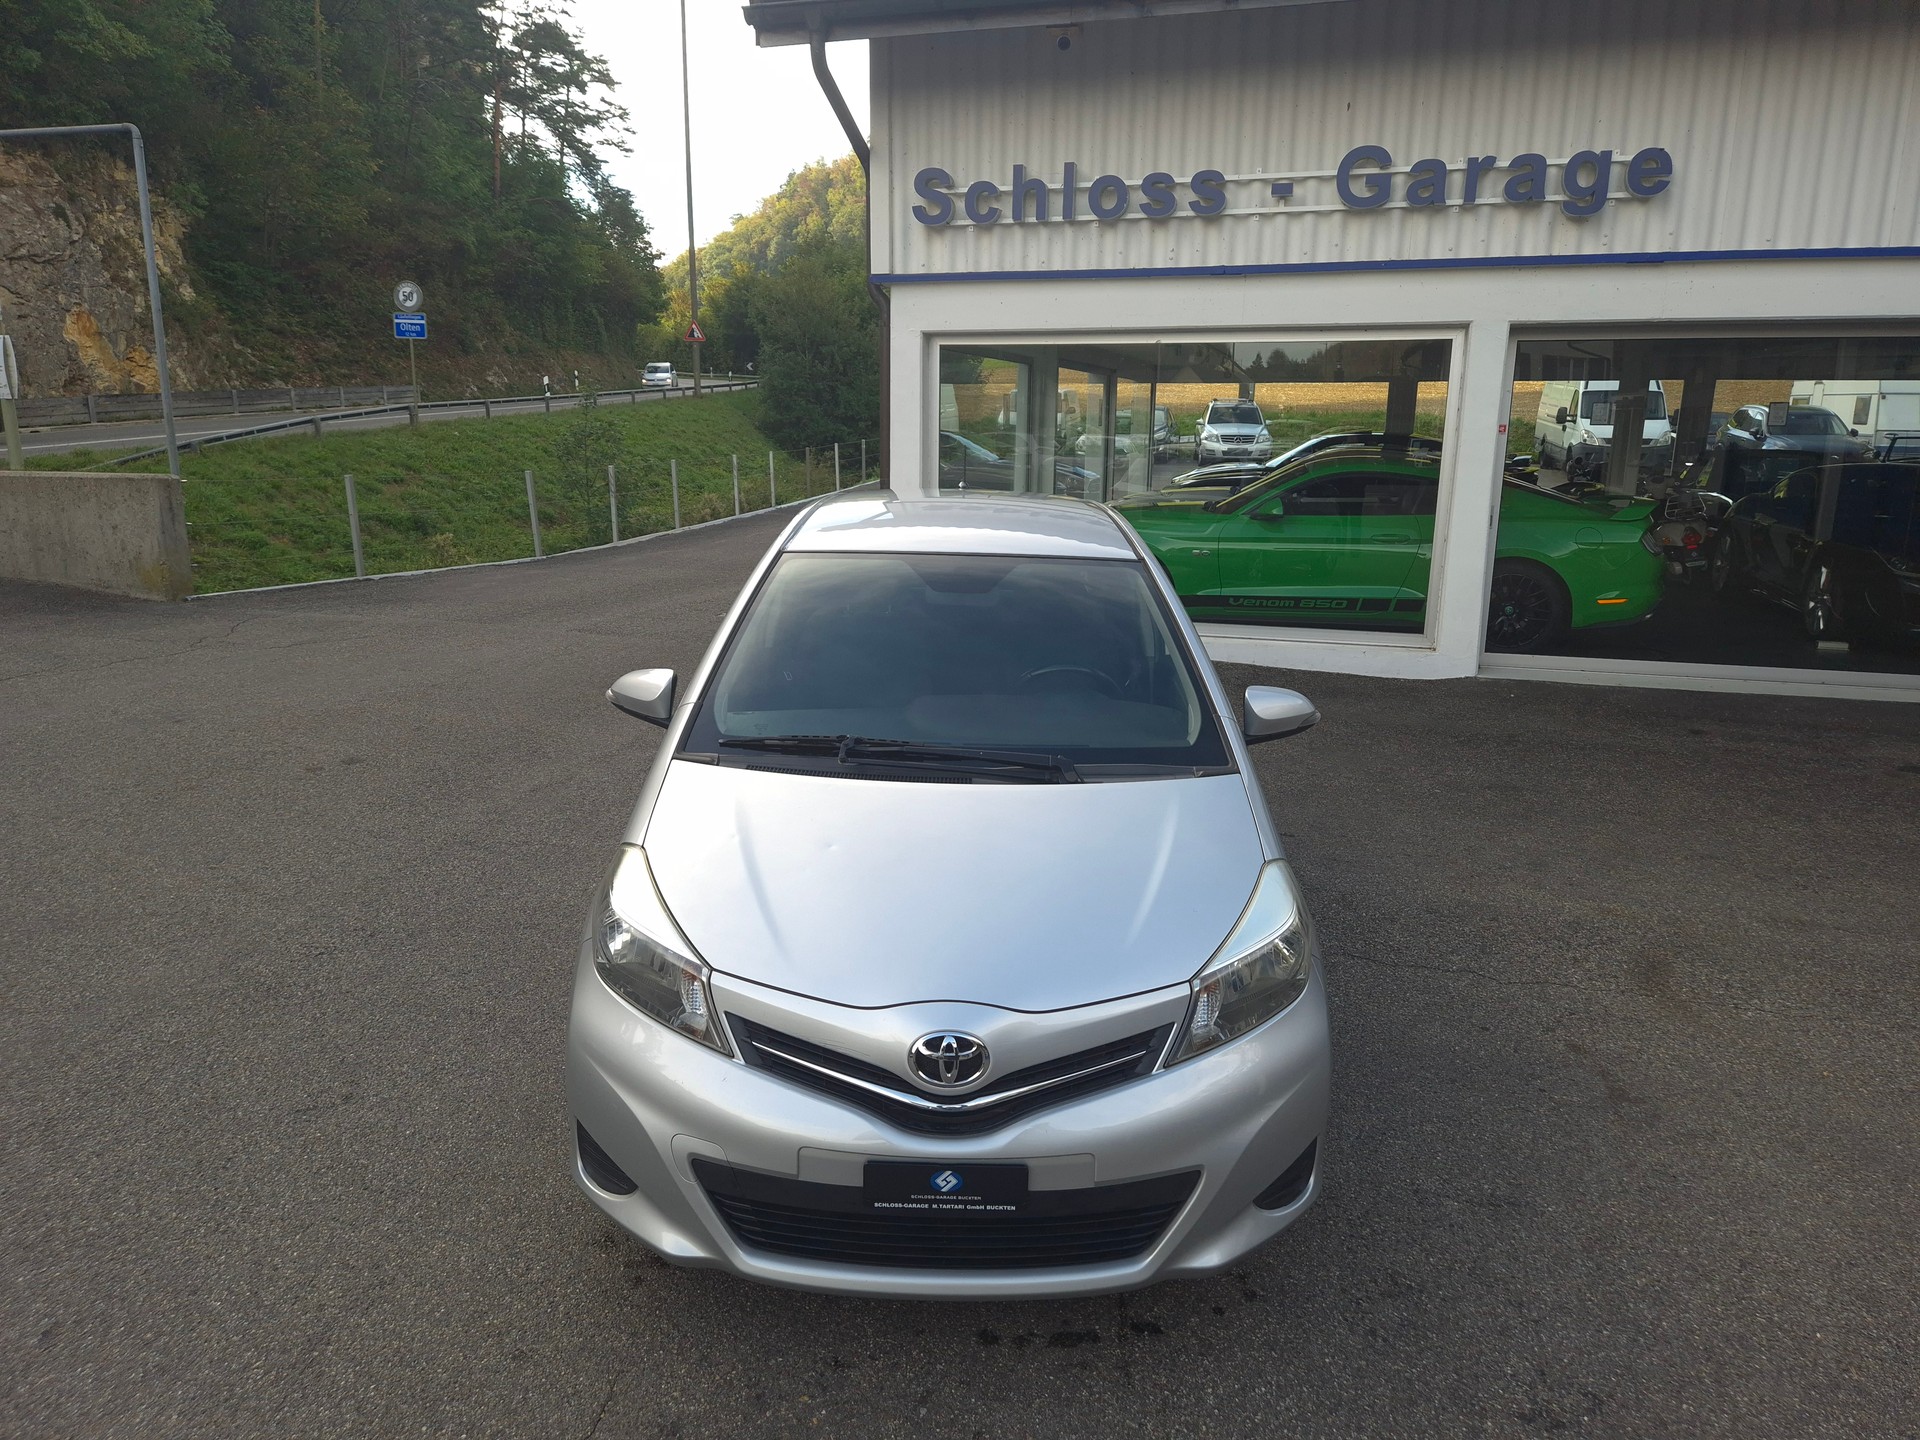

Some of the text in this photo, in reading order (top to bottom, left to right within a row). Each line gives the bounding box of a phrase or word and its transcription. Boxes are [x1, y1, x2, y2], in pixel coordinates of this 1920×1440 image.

[912, 161, 1228, 227] Schloss
[1336, 144, 1674, 222] Garage
[402, 290, 414, 302] 50
[400, 322, 421, 332] Olten
[1228, 597, 1348, 609] Venom 850
